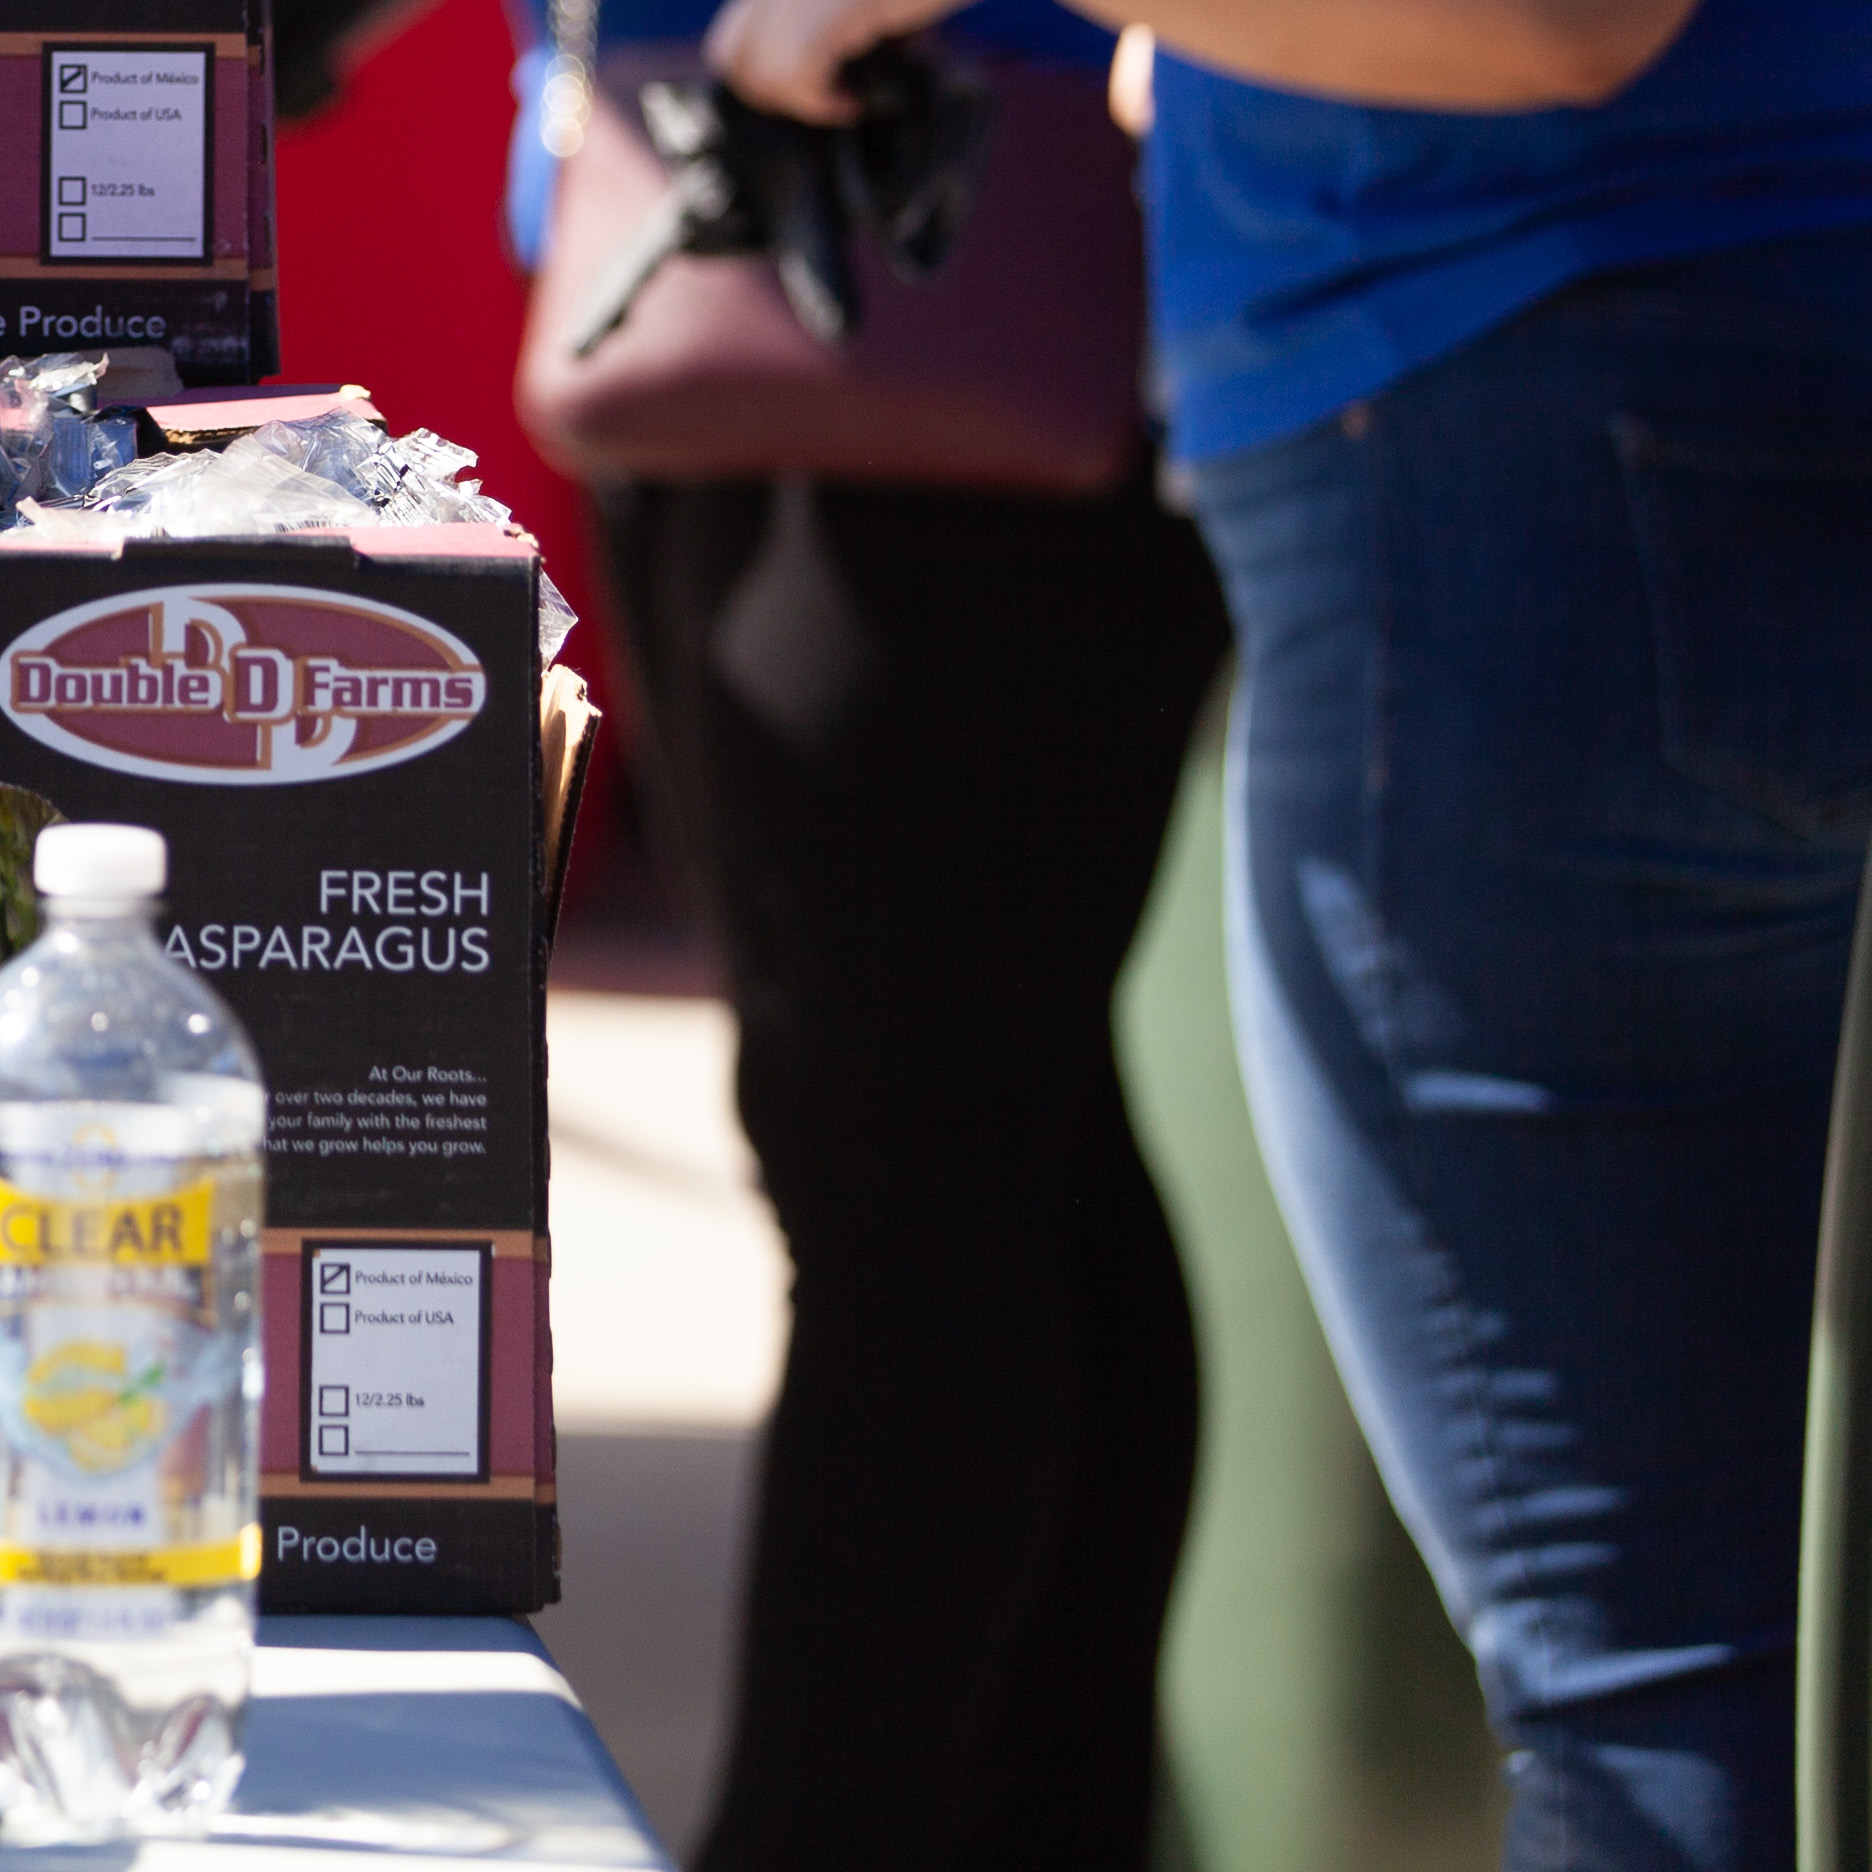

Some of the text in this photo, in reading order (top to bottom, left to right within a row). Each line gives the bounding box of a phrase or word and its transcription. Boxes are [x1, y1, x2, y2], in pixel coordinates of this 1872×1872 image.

[91, 72, 138, 85] Product
[141, 71, 154, 84] of
[91, 108, 182, 120] Product of USA
[19, 305, 167, 339] Produce
[15, 649, 475, 720] Double D Farms
[320, 870, 489, 916] FRESH
[164, 924, 490, 972] ASPARAGUS
[368, 1066, 387, 1082] At
[392, 1066, 423, 1083] Our
[275, 1091, 307, 1105] over
[313, 1091, 343, 1105] two
[347, 1090, 417, 1107] decades,
[422, 1093, 445, 1105] we
[449, 1091, 487, 1106] have
[269, 1112, 487, 1133] your family with the freshest
[263, 1137, 287, 1152] hat
[291, 1140, 314, 1152] we
[319, 1140, 357, 1157] grow
[363, 1136, 404, 1156] helps
[408, 1141, 438, 1158] you
[354, 1270, 473, 1286] Product of México
[354, 1310, 454, 1325] Product of USA
[355, 1393, 425, 1407] 12/2.25 lbs
[277, 1526, 438, 1564] Produce
